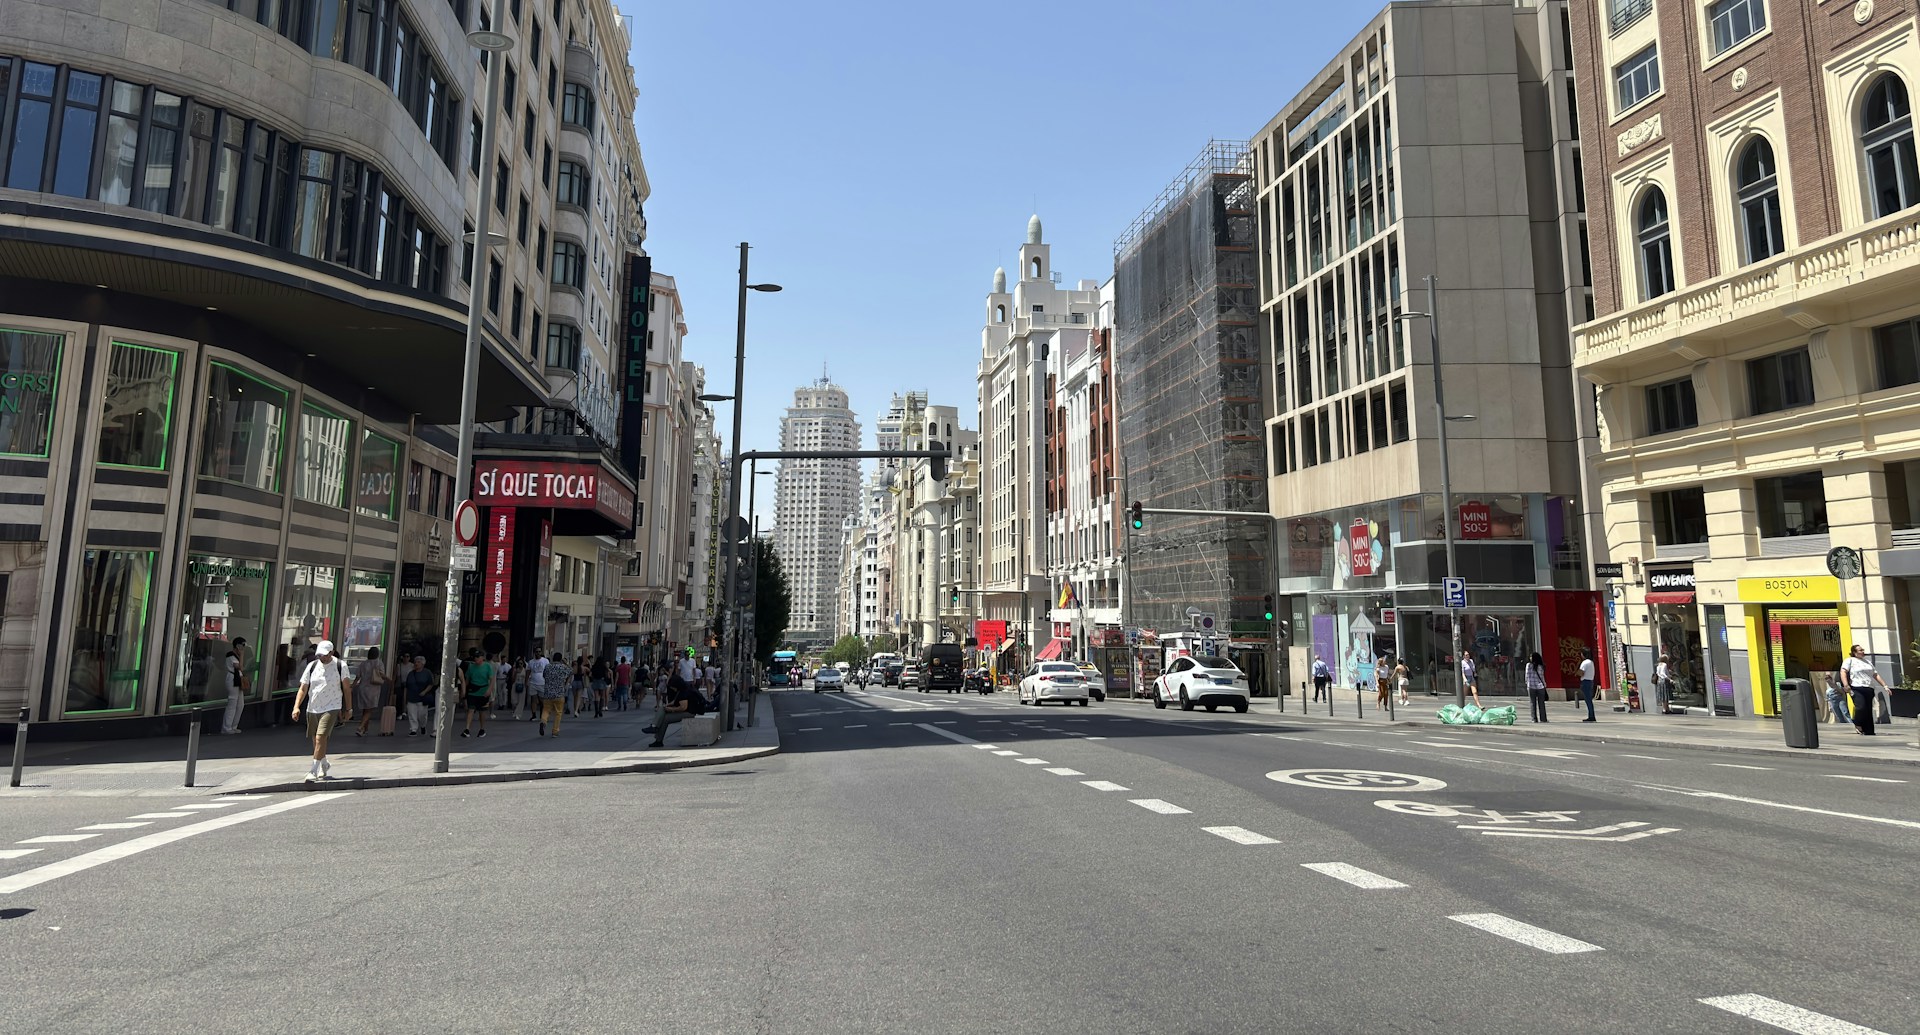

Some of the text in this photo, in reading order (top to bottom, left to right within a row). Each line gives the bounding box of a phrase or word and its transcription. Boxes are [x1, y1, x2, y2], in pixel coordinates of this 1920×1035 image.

[628, 286, 646, 402] HOTEL
[478, 468, 594, 498] SÍ QUE TOCA!
[1463, 512, 1487, 522] MINI
[706, 480, 720, 616] HOTEL EMPERADOR
[1352, 536, 1368, 550] MINI
[1446, 578, 1462, 599] P
[1766, 580, 1808, 590] BOSTON
